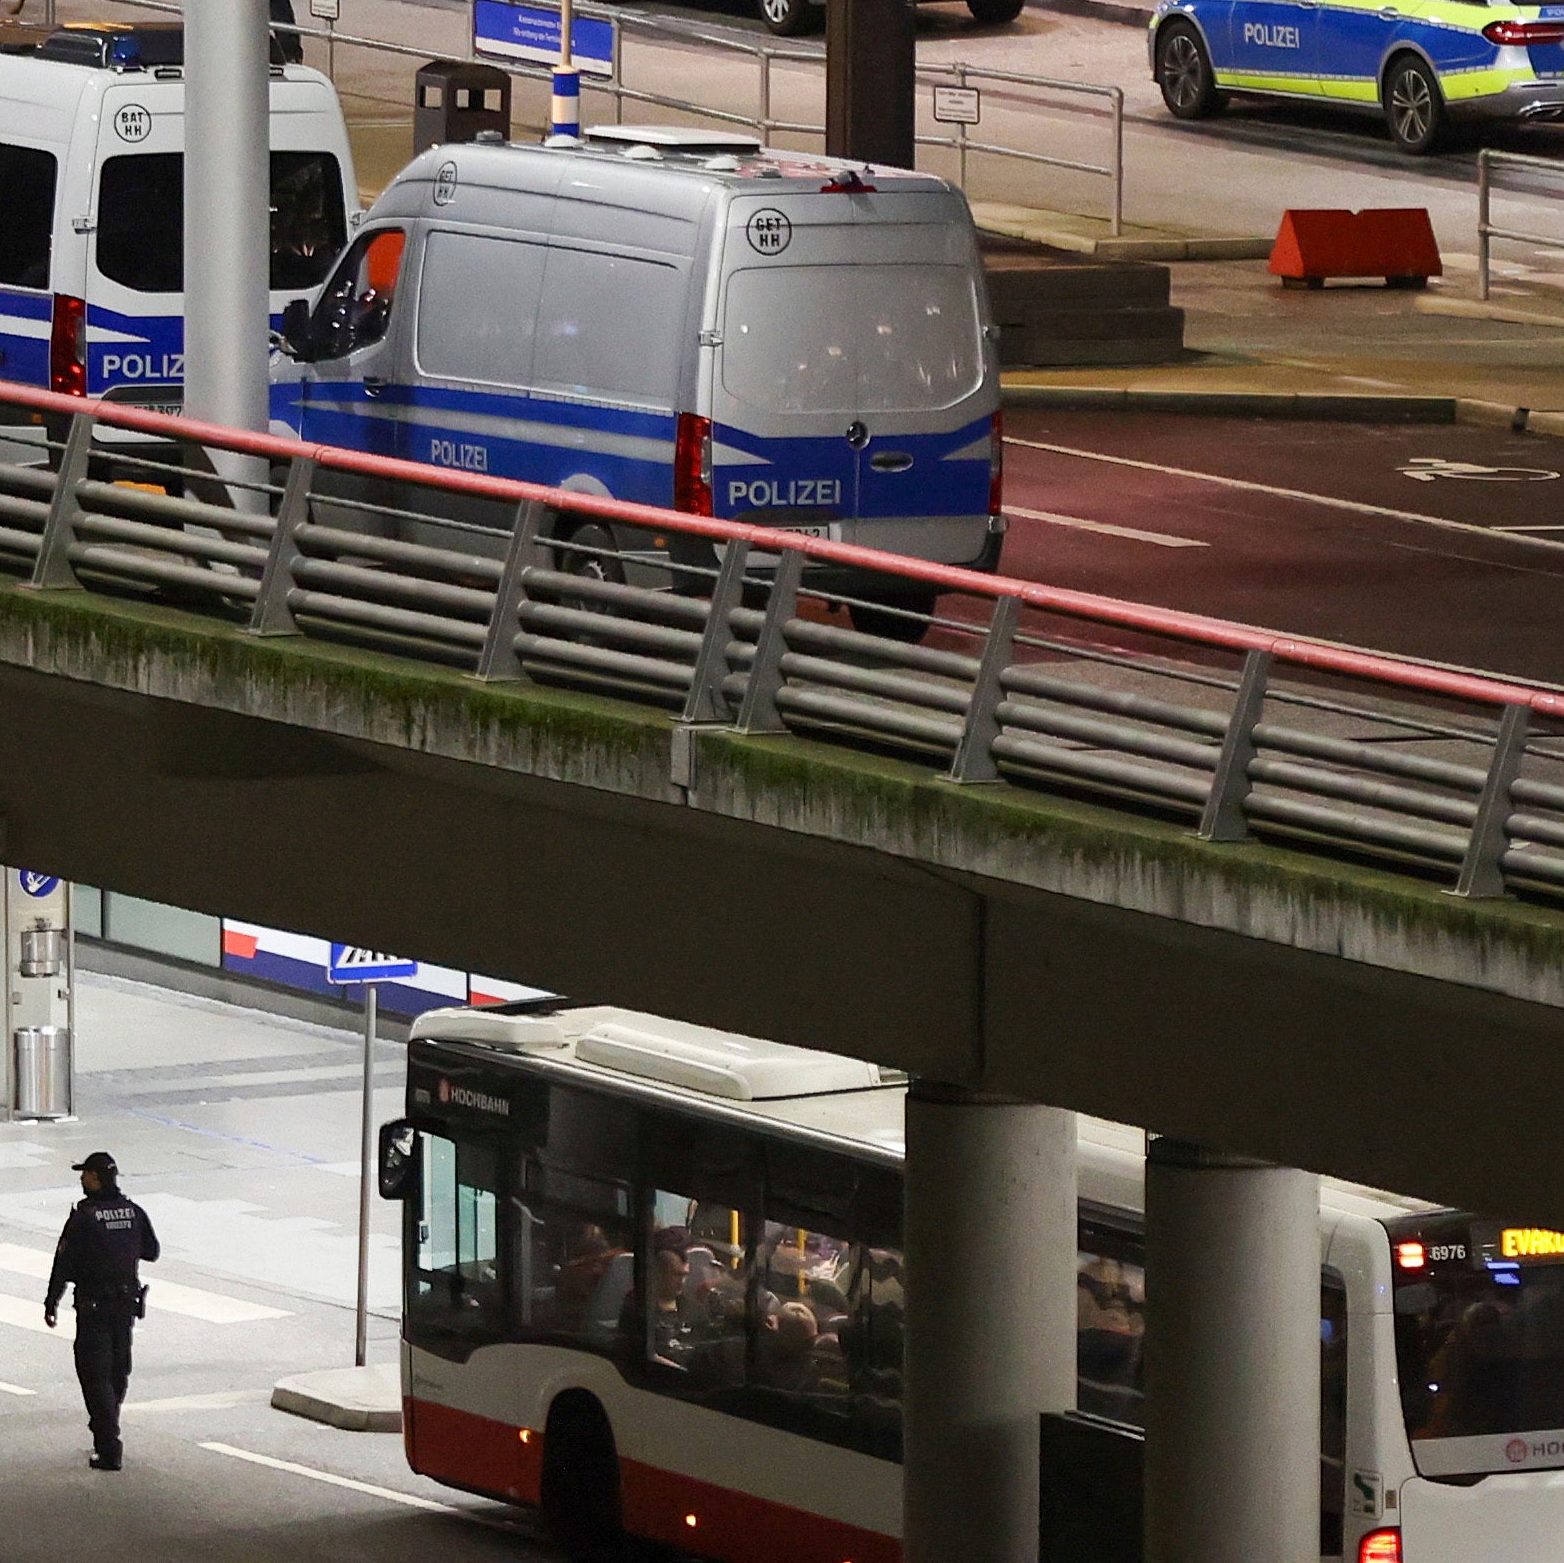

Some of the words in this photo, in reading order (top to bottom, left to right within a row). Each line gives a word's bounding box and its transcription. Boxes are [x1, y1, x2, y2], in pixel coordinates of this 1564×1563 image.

[1244, 23, 1300, 49] POLIZEI
[121, 112, 143, 123] BAT
[125, 125, 142, 136] HH
[756, 217, 782, 231] GET
[760, 234, 780, 247] HH
[102, 354, 184, 379] POLIZ
[431, 439, 487, 471] POLIZEI
[729, 479, 841, 507] POLIZEI
[451, 1086, 509, 1116] HOCHBAHN
[95, 1208, 135, 1221] POLIZEI
[1430, 1244, 1466, 1261] 6976
